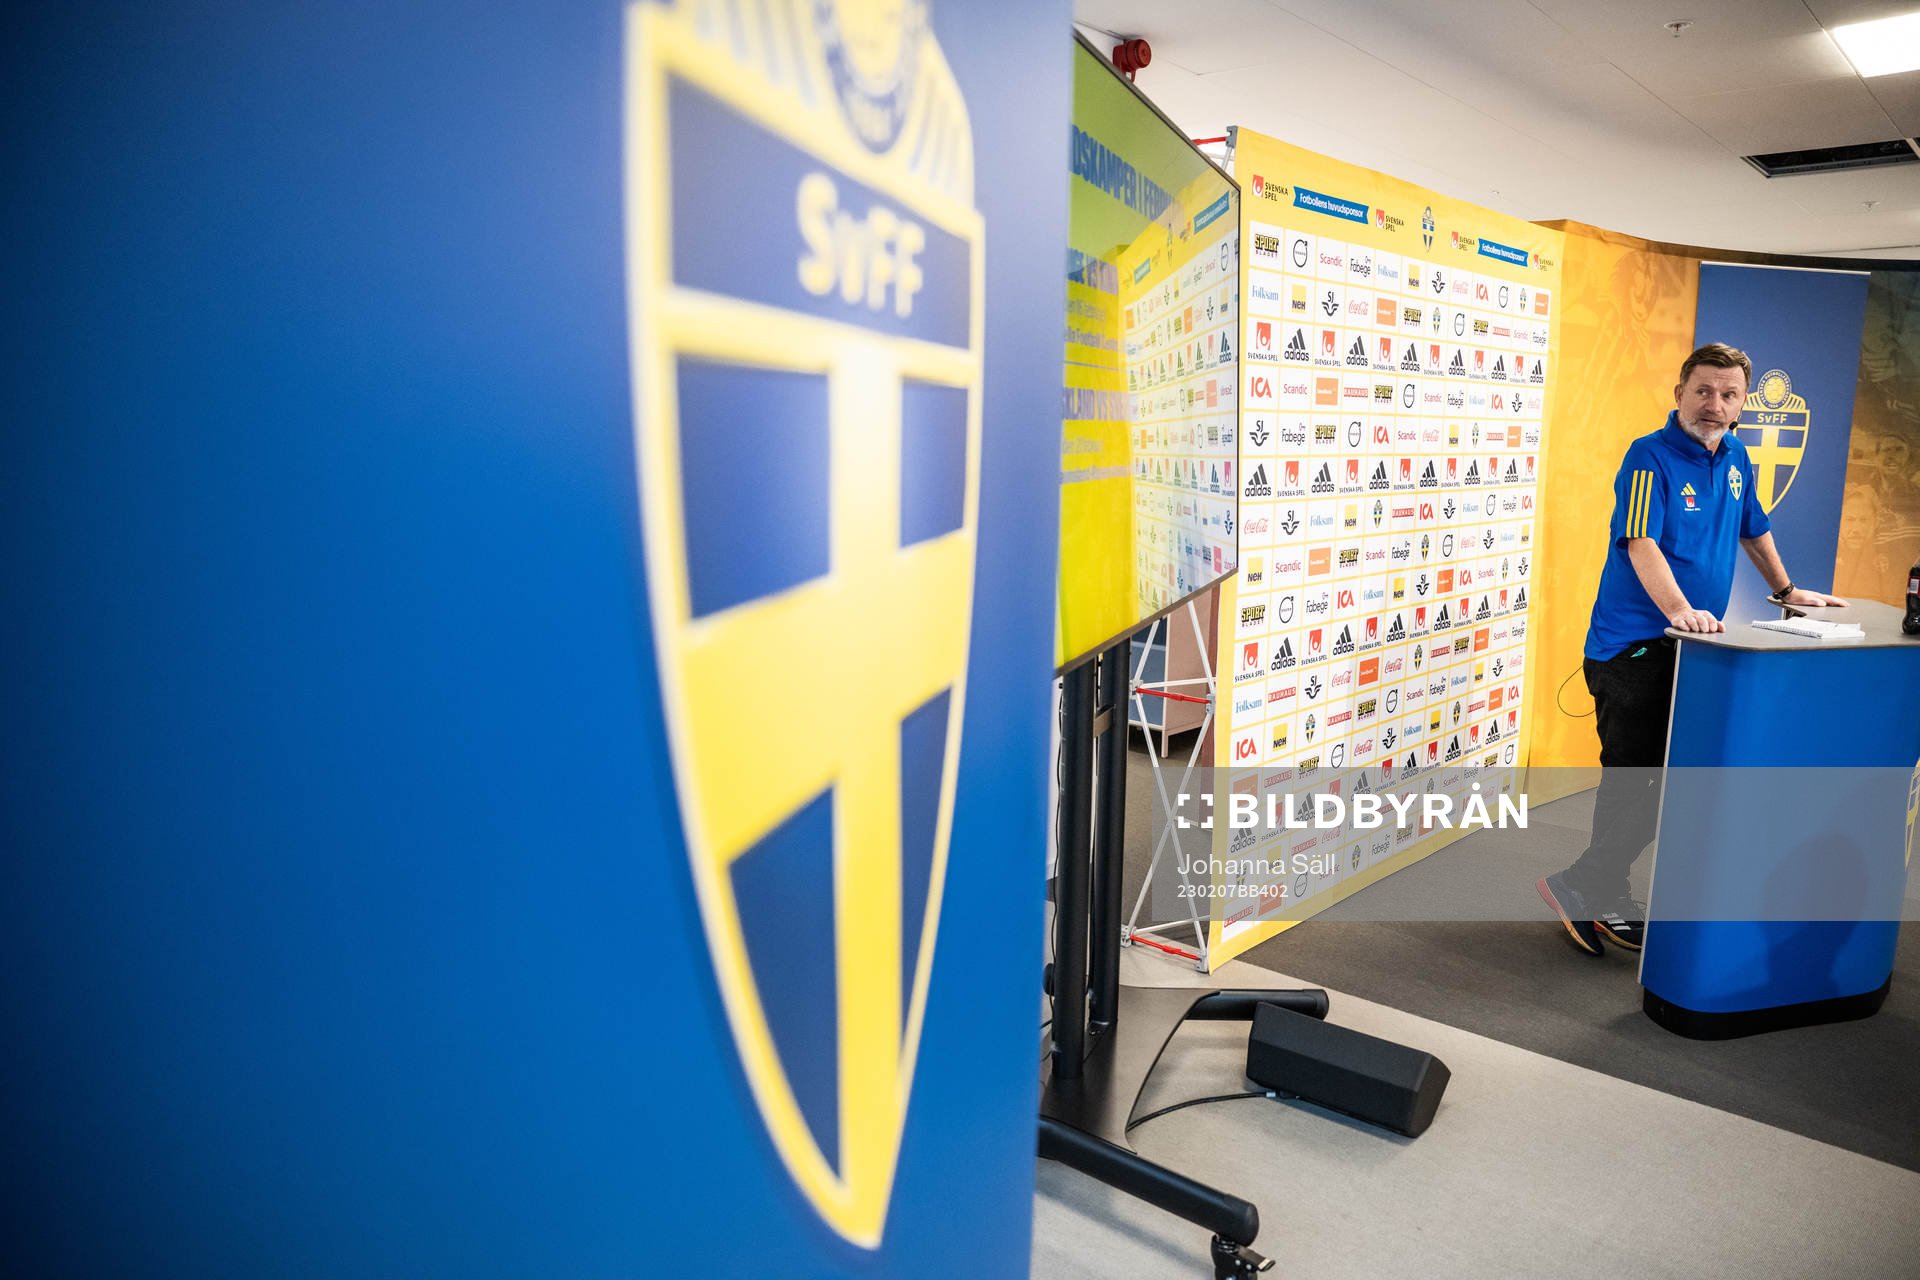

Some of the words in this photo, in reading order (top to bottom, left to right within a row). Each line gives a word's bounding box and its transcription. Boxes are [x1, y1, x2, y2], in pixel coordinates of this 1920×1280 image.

[1265, 182, 1288, 195] SVENSKA
[1265, 192, 1277, 201] SPEL
[1300, 193, 1327, 209] Fotbollens
[1328, 200, 1363, 218] huvudsponsor
[1385, 222, 1395, 232] SPEL
[1386, 216, 1404, 226] SVENSKA
[1255, 234, 1279, 252] SPORT
[1320, 253, 1342, 267] Scandic
[1350, 258, 1371, 277] Fabege
[1252, 286, 1279, 302] Folksam
[1328, 291, 1334, 302] SJ
[1476, 283, 1488, 301] ICA
[1248, 352, 1268, 360] SVENSKA
[1268, 354, 1278, 362] SPEL
[1284, 350, 1309, 362] adidas
[1346, 356, 1368, 366] adidas
[1401, 363, 1420, 372] adidas
[1449, 368, 1465, 376] adidas
[1251, 376, 1272, 398] ICA
[1284, 384, 1308, 395] Scandic
[1492, 394, 1503, 410] ICA
[1757, 413, 1787, 423] SvFF
[1256, 420, 1264, 432] SJ
[1315, 425, 1336, 439] SPORT
[1282, 429, 1305, 446] Fabege
[1373, 426, 1389, 444] ICA
[1398, 431, 1416, 441] Scandic
[1369, 481, 1390, 490] adidas
[1420, 479, 1437, 488] adidas
[1464, 477, 1480, 485] adidas
[1245, 485, 1271, 497] adidas
[1311, 482, 1334, 493] adidas
[1522, 495, 1532, 510] ICA
[1288, 510, 1294, 521] SJ
[1420, 503, 1434, 520] ICA
[1310, 515, 1333, 527] Folksam
[1366, 550, 1385, 561] Scandic
[1391, 546, 1410, 561] Fabege
[1275, 560, 1301, 574] Scandic
[1459, 570, 1472, 586] ICA
[1478, 568, 1494, 579] Scandic
[1337, 590, 1354, 609] ICA
[1363, 590, 1384, 600] Folksam
[1306, 600, 1328, 614] Fabege
[1241, 605, 1265, 623] SPORT
[1476, 611, 1492, 621] adidas
[1434, 621, 1451, 631] adidas
[1386, 631, 1406, 642] adidas
[1333, 643, 1355, 656] adidas
[1271, 657, 1296, 670] adidas
[1301, 657, 1318, 666] SVENSKA
[1235, 672, 1255, 682] SVENSKA
[1310, 675, 1317, 686] SJ
[1268, 687, 1296, 703] BAUHAUS
[1406, 689, 1424, 701] Scandic
[1429, 685, 1446, 696] Fabege
[1508, 685, 1519, 701] ICA
[1235, 699, 1262, 714] Folksam
[1327, 711, 1352, 726] BAUHAUS
[1387, 728, 1393, 737] SJ
[1403, 725, 1422, 737] Folksam
[1485, 734, 1500, 745] adidas
[1236, 737, 1256, 761] ICA
[1445, 750, 1461, 762] adidas
[1401, 768, 1419, 780] adidas
[1230, 835, 1256, 853] adidas
[1371, 840, 1390, 856] Fabege
[1224, 905, 1254, 928] BAUHAUS
